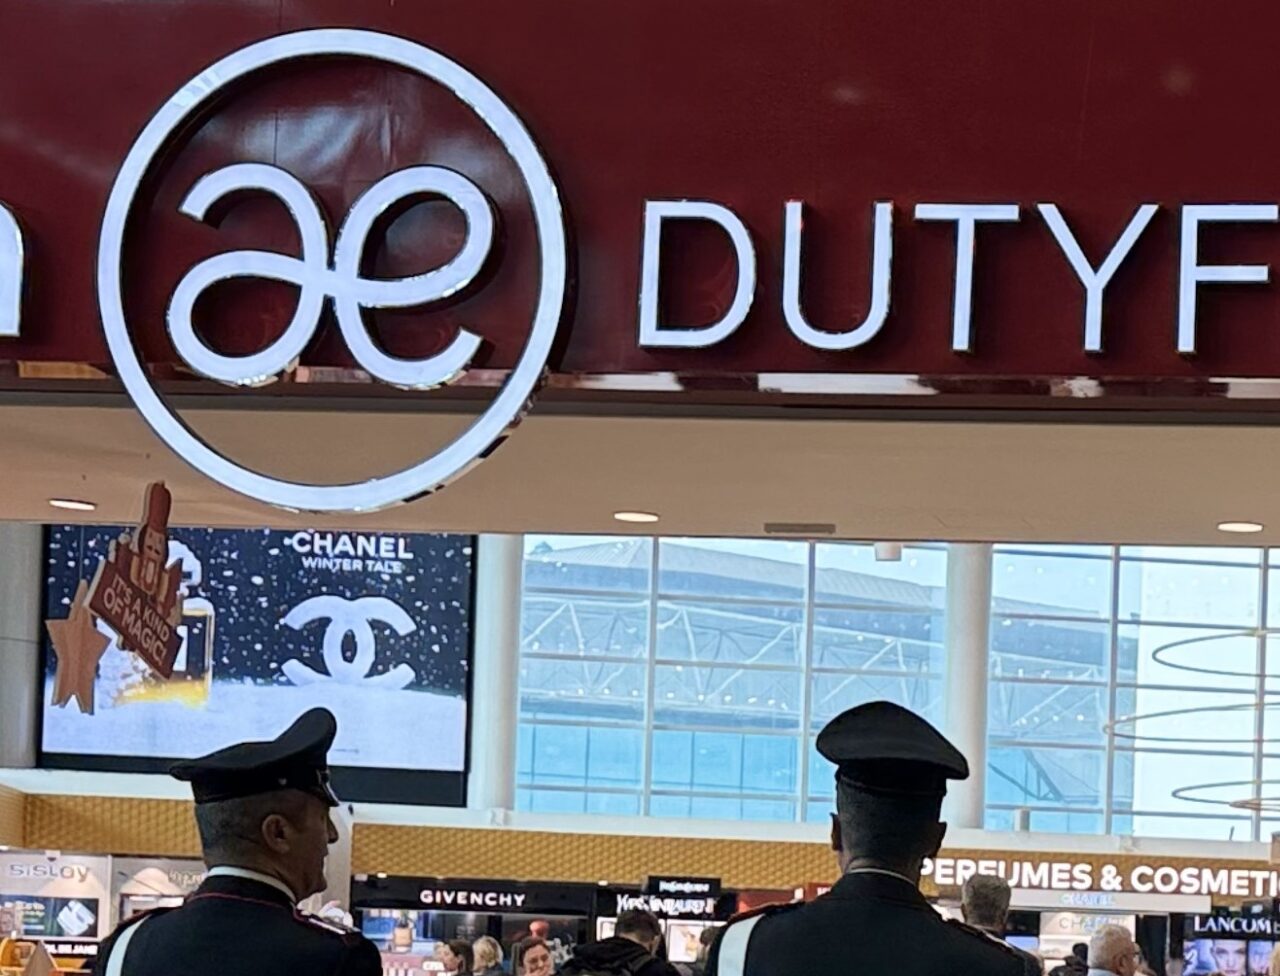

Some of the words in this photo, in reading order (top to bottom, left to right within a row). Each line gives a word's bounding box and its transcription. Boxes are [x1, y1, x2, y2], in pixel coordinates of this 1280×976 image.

[292, 532, 413, 559] CHANEL
[302, 556, 363, 571] WINTER
[366, 560, 403, 573] TALE
[112, 574, 133, 605] IT'S
[132, 598, 141, 615] A
[142, 606, 170, 642] KIND
[103, 587, 124, 615] OF
[121, 608, 167, 666] MAGIC!
[1101, 863, 1123, 891] &
[420, 890, 525, 907] GIVENCHY
